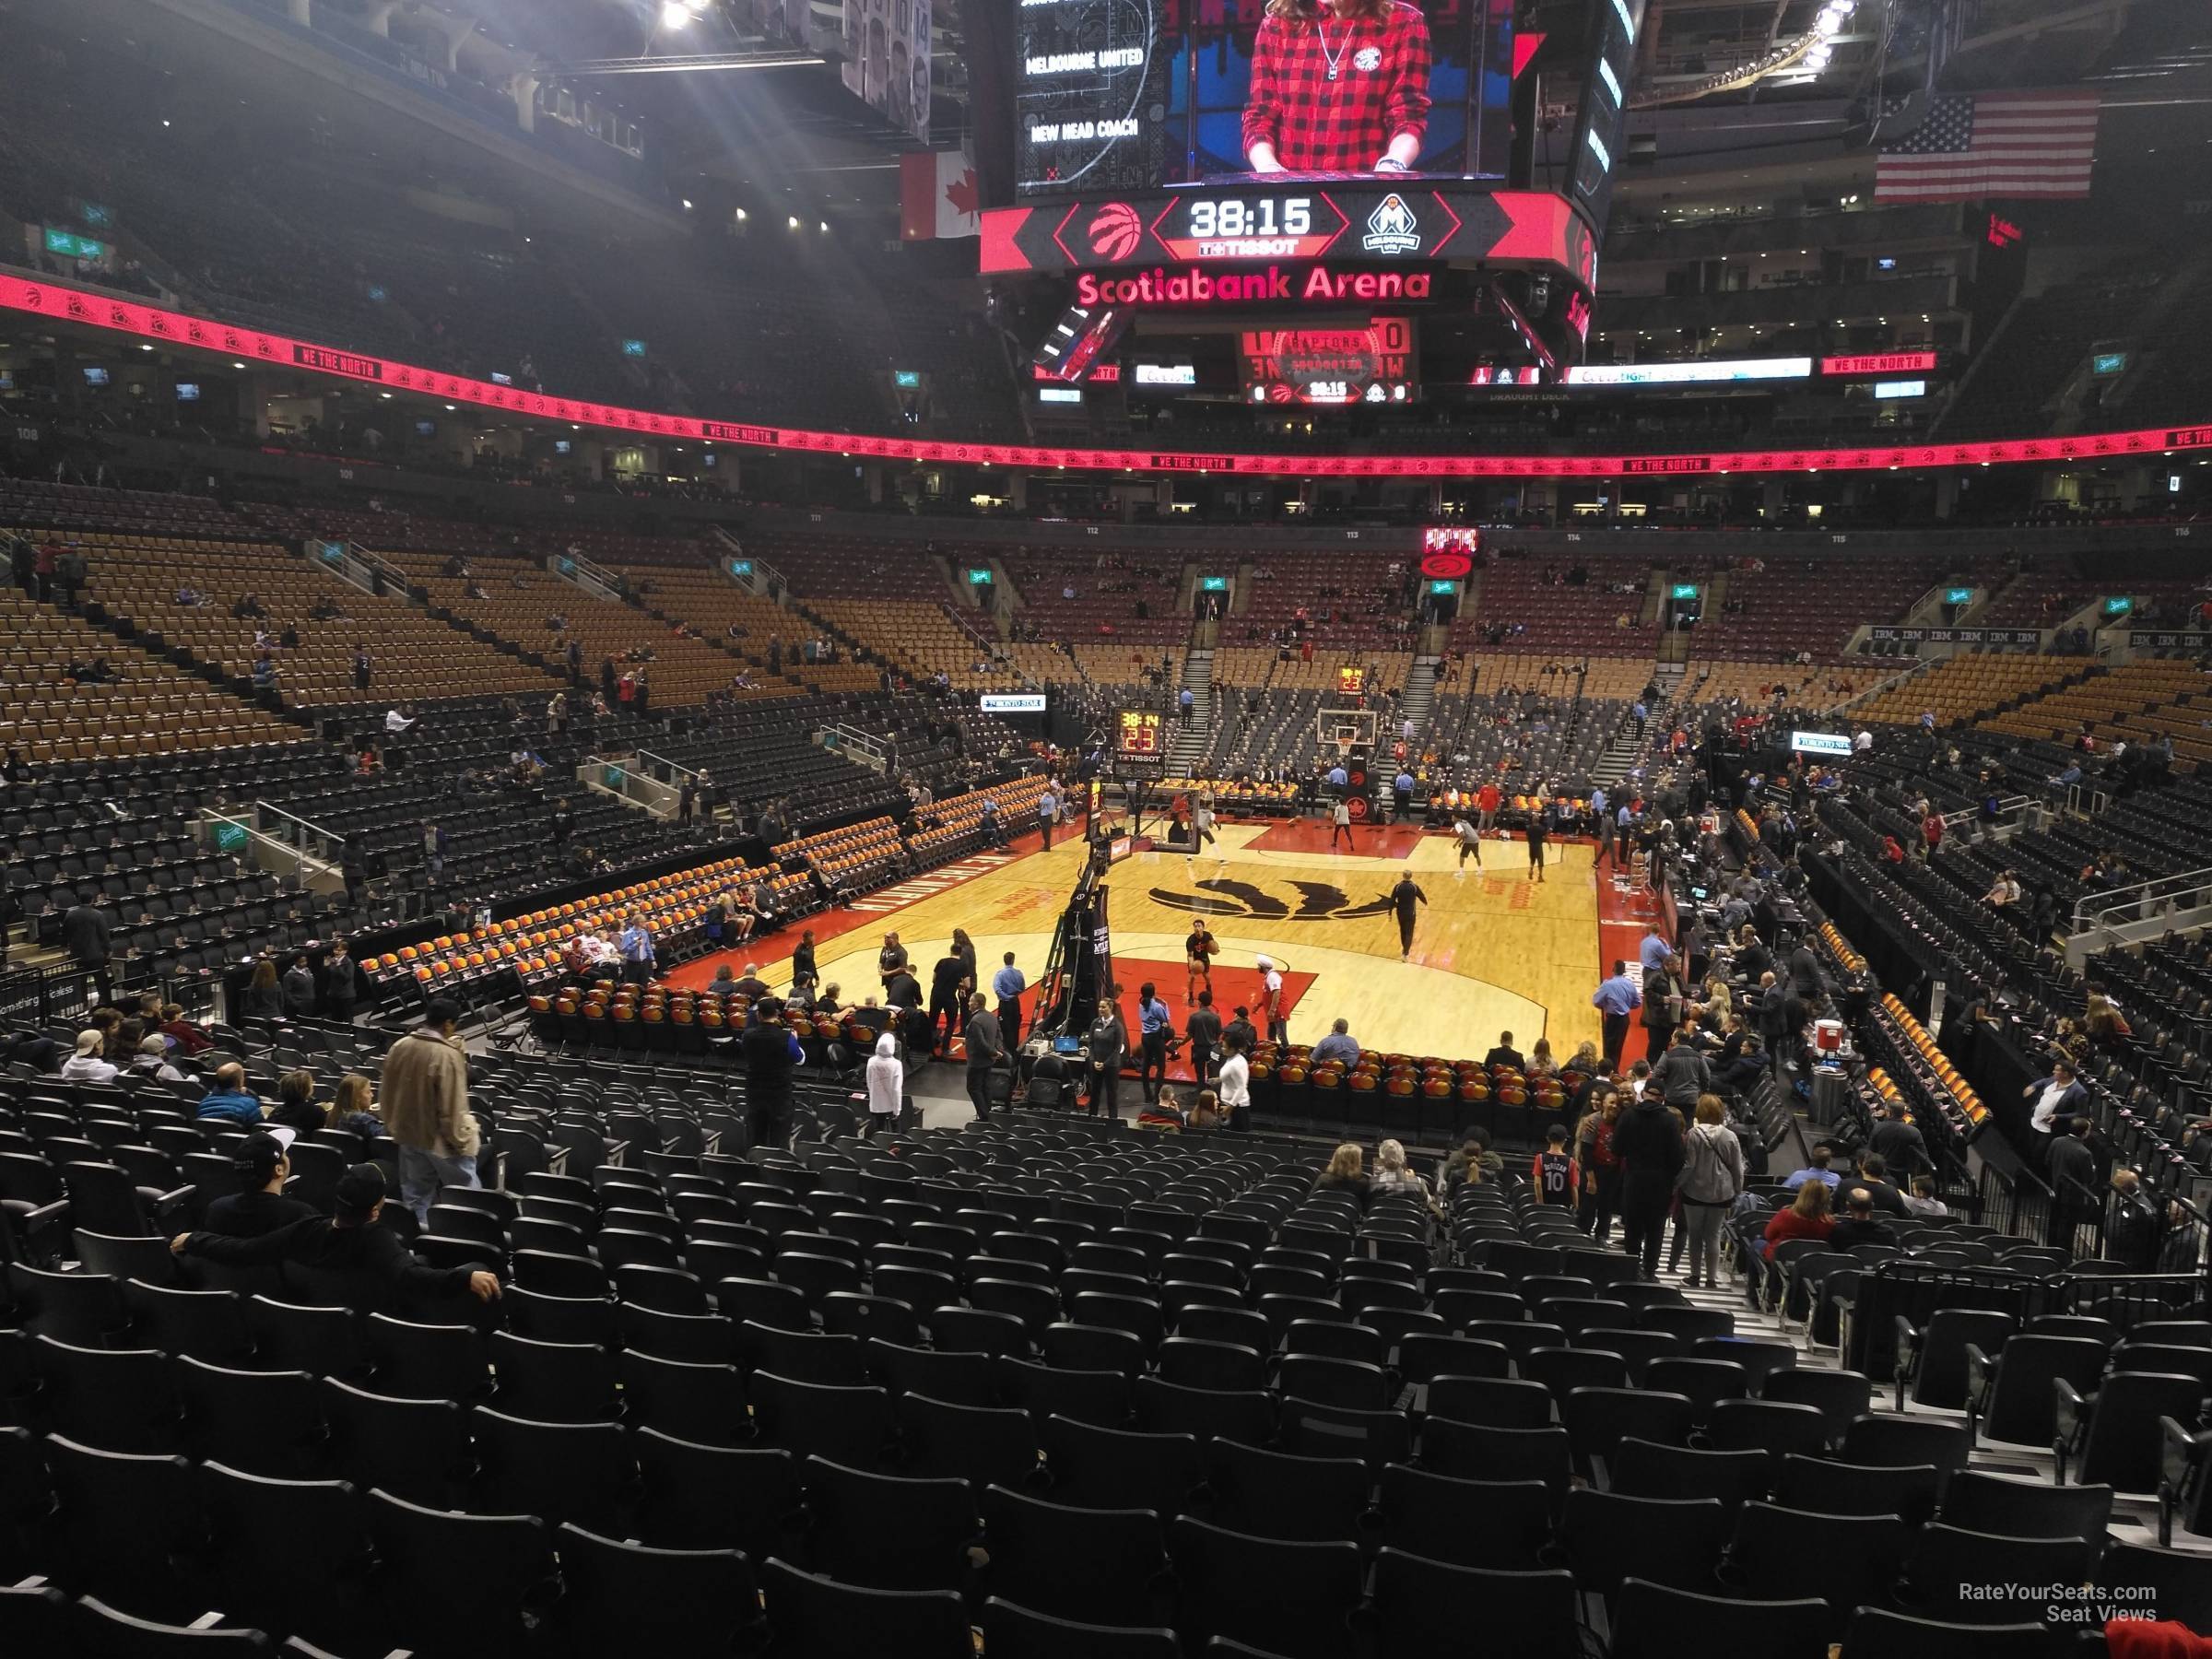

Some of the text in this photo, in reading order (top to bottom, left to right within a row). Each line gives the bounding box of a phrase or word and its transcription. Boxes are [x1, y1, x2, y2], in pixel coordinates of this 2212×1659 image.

[1026, 48, 1144, 75] MELBOURNE UNITED
[1031, 119, 1138, 143] NEW HEAD COACH
[1190, 198, 1311, 237] 38:15
[1227, 240, 1299, 255] TISSOT
[1078, 266, 1430, 304] Scotiabank Arena
[1292, 337, 1360, 348] RAPTORS
[303, 348, 373, 377] WE THE NORTH
[1835, 356, 1922, 371] WE THE NORTH
[17, 428, 39, 441] 108
[710, 425, 771, 442] WE THE NORTH
[2195, 429, 2212, 443] TH
[1159, 456, 1226, 468] WE THE NORTH
[1630, 459, 1701, 471] WE THE NORTH
[1347, 531, 1359, 539] 113
[2175, 527, 2190, 536] 116
[1875, 629, 2036, 642] IBM IBM IBM IBM IBM IBM
[2133, 635, 2203, 646] IBM IBM IBM
[1344, 677, 1359, 688] 23
[1122, 712, 1159, 727] 38:14
[1125, 727, 1153, 750] 23
[1834, 741, 1851, 749] STA
[218, 825, 243, 847] Sprite
[922, 865, 992, 881] THE
[850, 879, 954, 912] NORTH
[49, 984, 74, 999] iceless
[1546, 1171, 1564, 1192] 10
